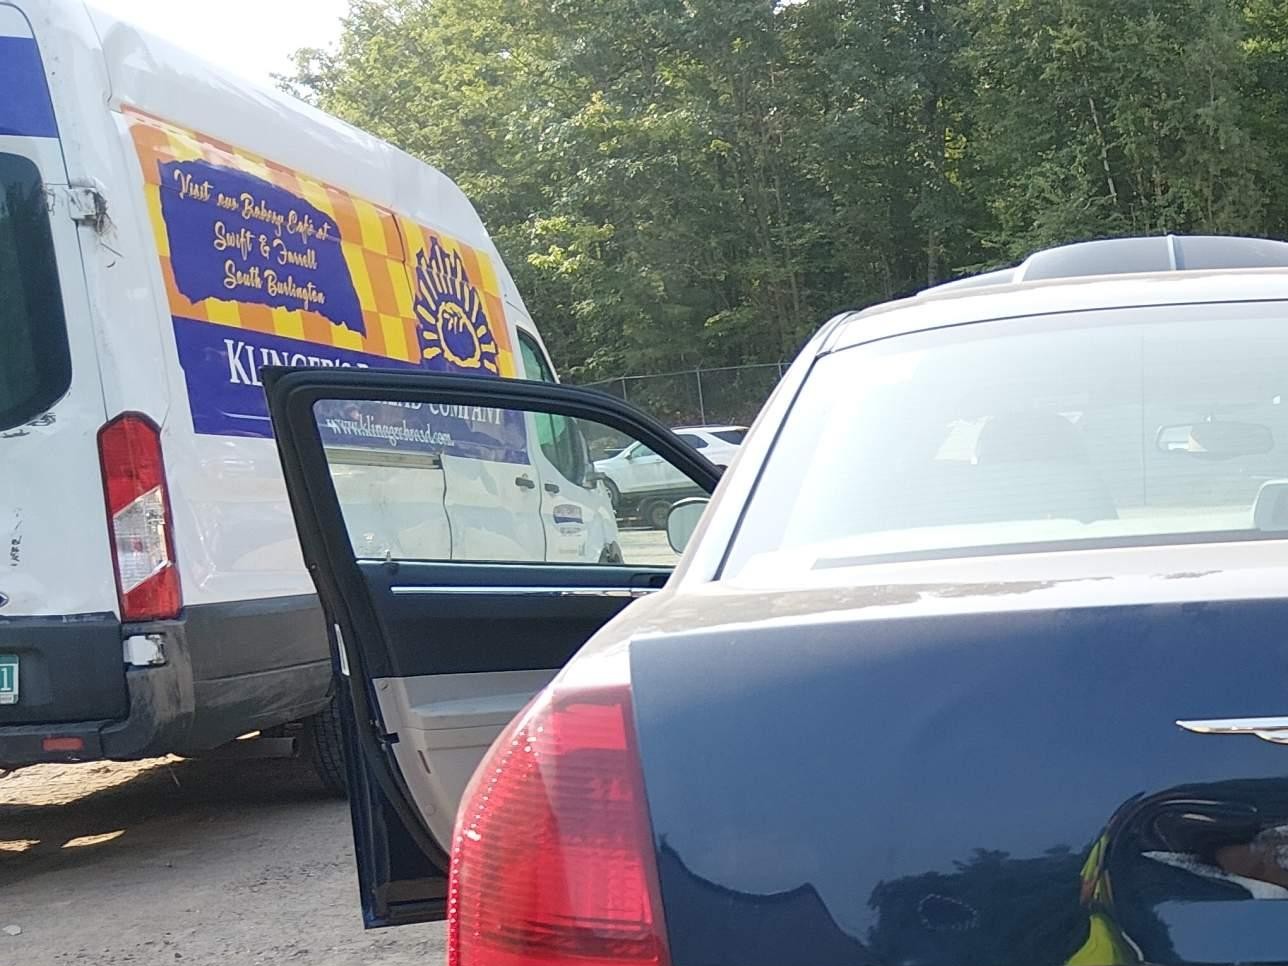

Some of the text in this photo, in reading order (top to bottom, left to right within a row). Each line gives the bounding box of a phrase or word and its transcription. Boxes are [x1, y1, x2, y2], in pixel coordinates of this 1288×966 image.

[174, 169, 213, 200] Visit
[240, 193, 284, 236] Bakery
[315, 222, 331, 240] at
[213, 221, 254, 260] Swift
[258, 235, 270, 259] &
[223, 259, 325, 310] South Burlington
